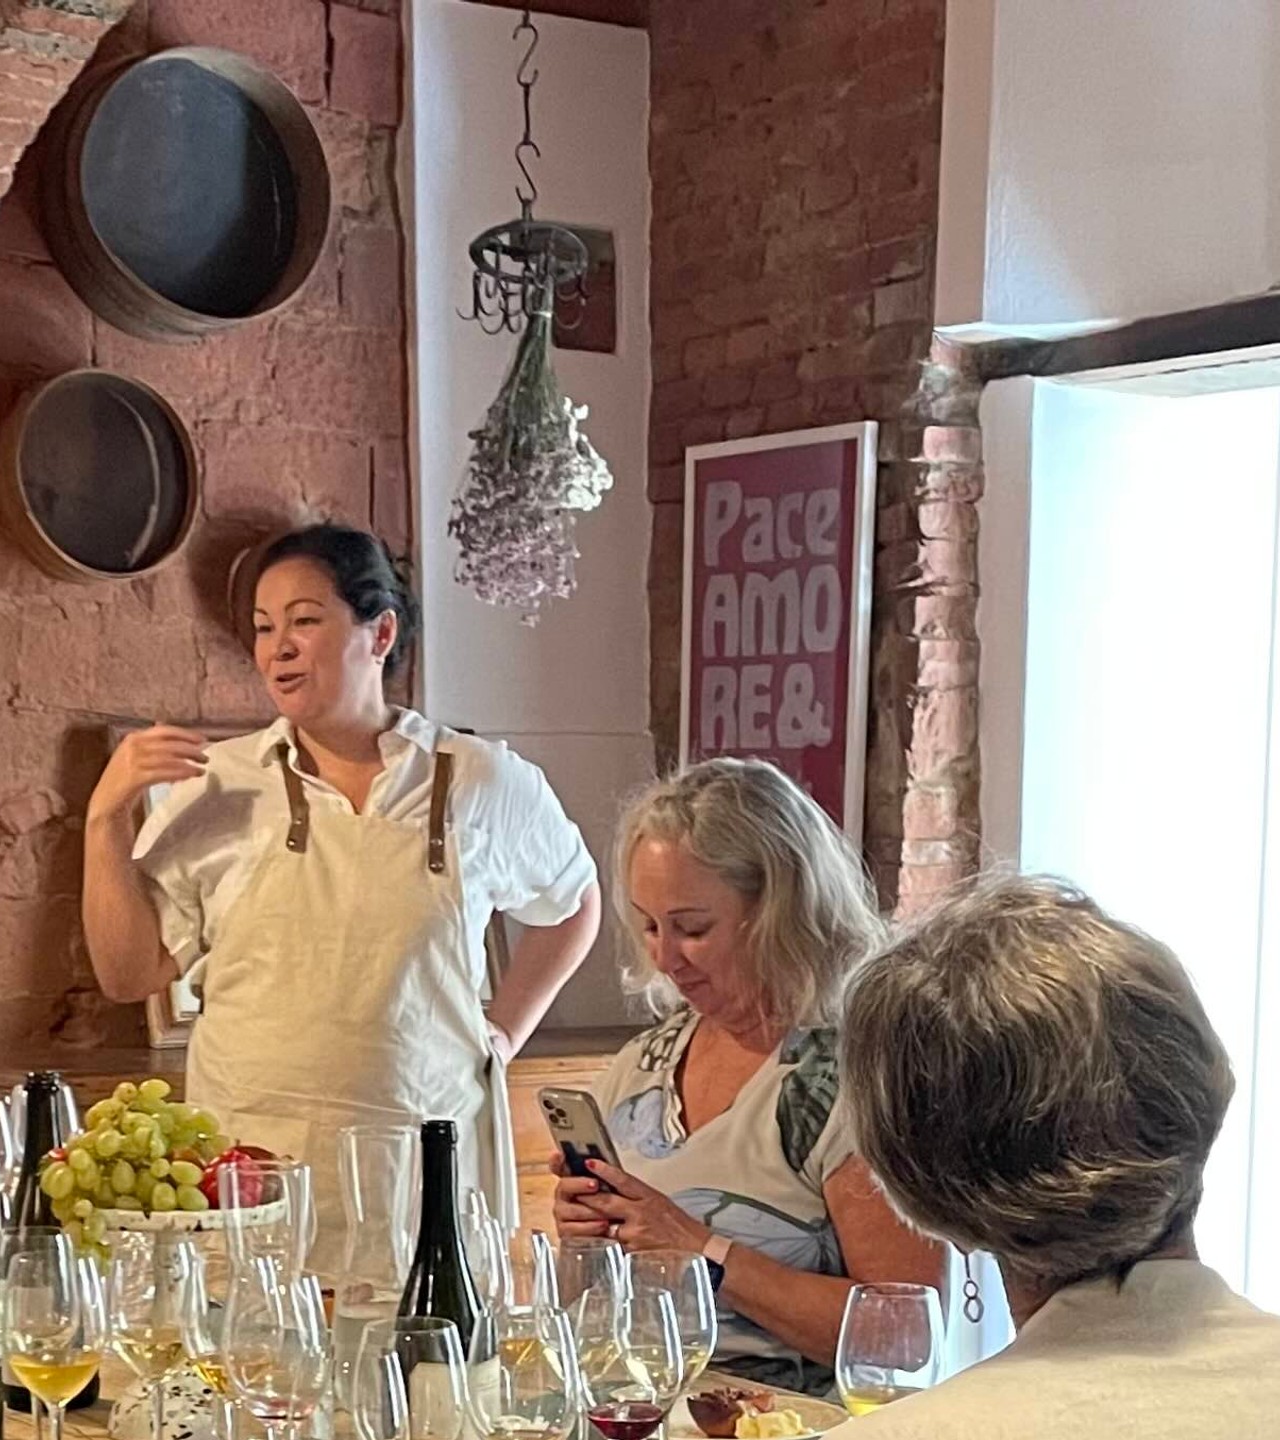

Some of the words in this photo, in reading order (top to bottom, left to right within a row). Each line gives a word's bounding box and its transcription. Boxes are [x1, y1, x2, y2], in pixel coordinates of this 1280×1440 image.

[704, 481, 841, 566] Pace
[702, 564, 842, 657] AMO
[700, 663, 833, 749] RE&
